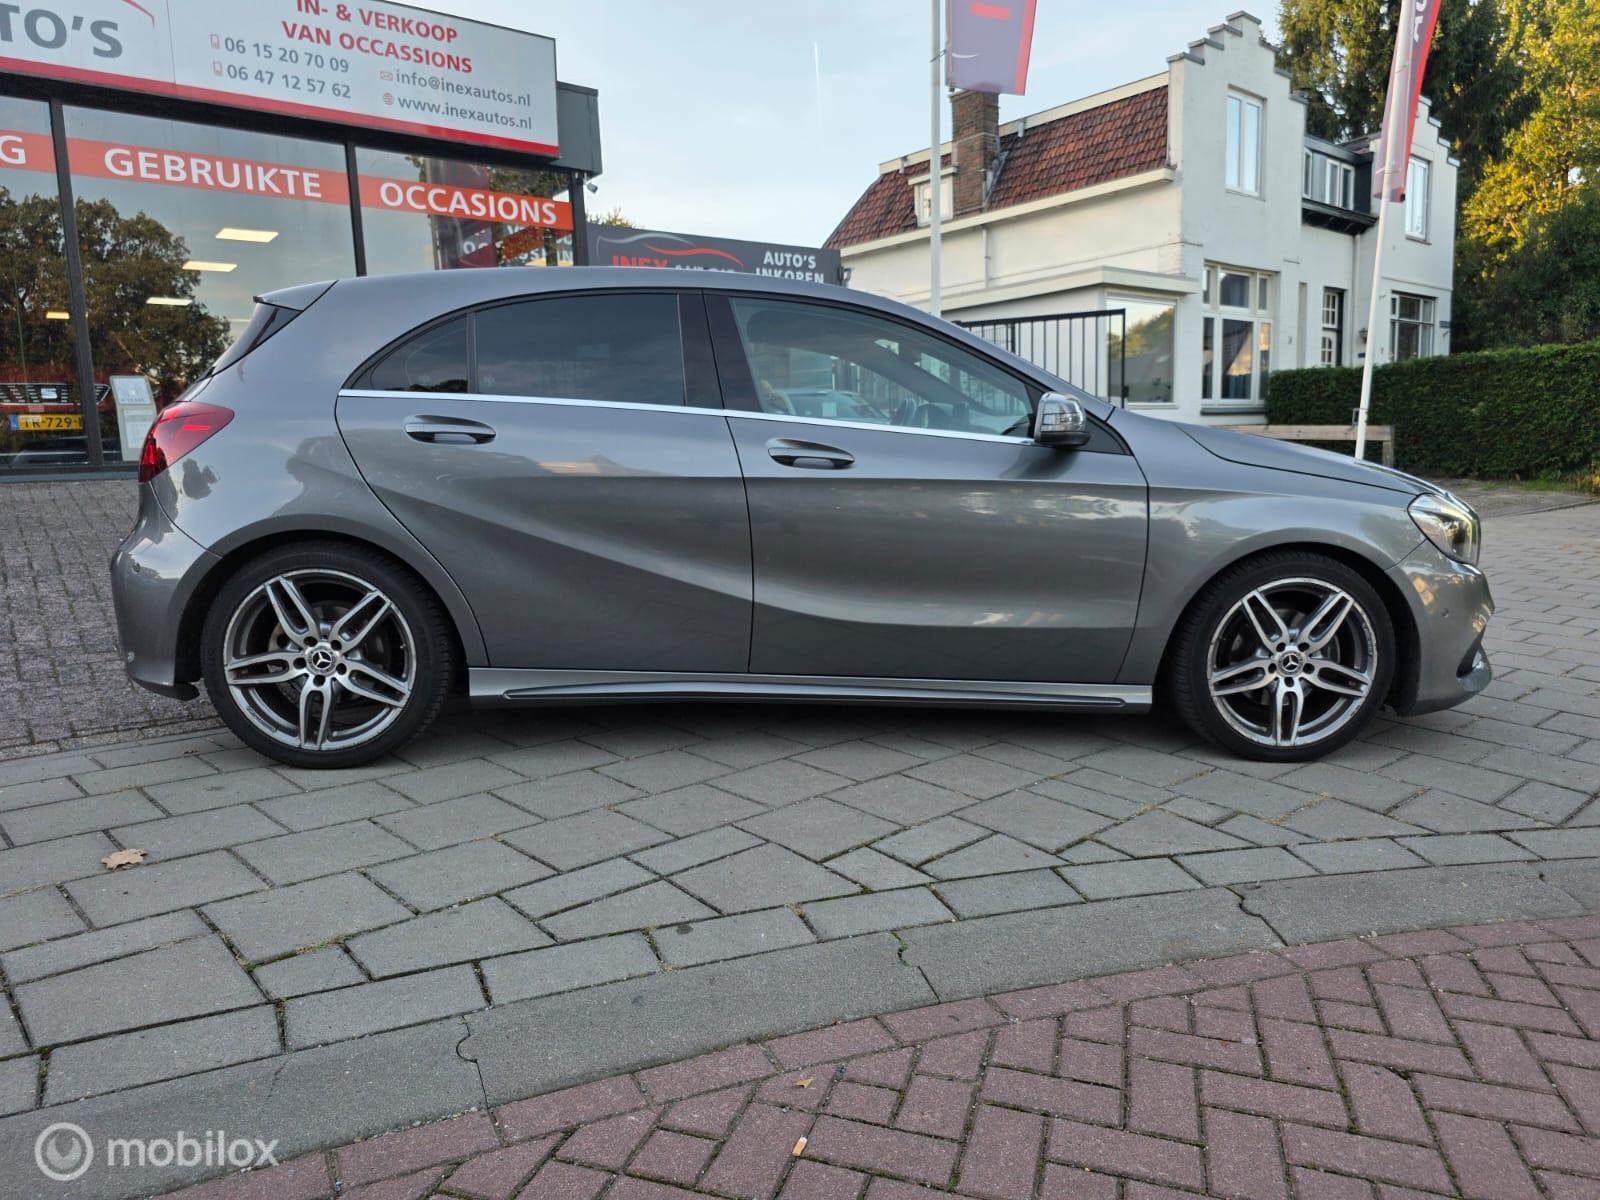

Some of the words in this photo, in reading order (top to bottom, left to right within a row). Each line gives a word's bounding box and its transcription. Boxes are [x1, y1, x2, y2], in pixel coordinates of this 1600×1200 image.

[297, 0, 328, 16] IN-
[336, 4, 351, 22] &
[358, 9, 457, 43] VERKOOP
[224, 37, 246, 54] 06
[253, 43, 272, 59] 15
[278, 48, 298, 64] 20
[304, 52, 324, 68] 70
[329, 57, 349, 73] 09
[281, 21, 331, 46] VAN
[339, 33, 472, 73] OCCASSIONS
[227, 64, 248, 81] 06
[254, 69, 274, 85] 47
[281, 74, 301, 90] 12
[306, 78, 325, 94] 57
[331, 83, 351, 99] 62
[396, 69, 531, 107] info@inexautos.nl
[398, 96, 532, 129] www.inexautos.nl
[104, 148, 322, 198] GEBRUIKTE
[379, 182, 557, 225] OCCASIONS
[763, 250, 816, 269] AUTO'S
